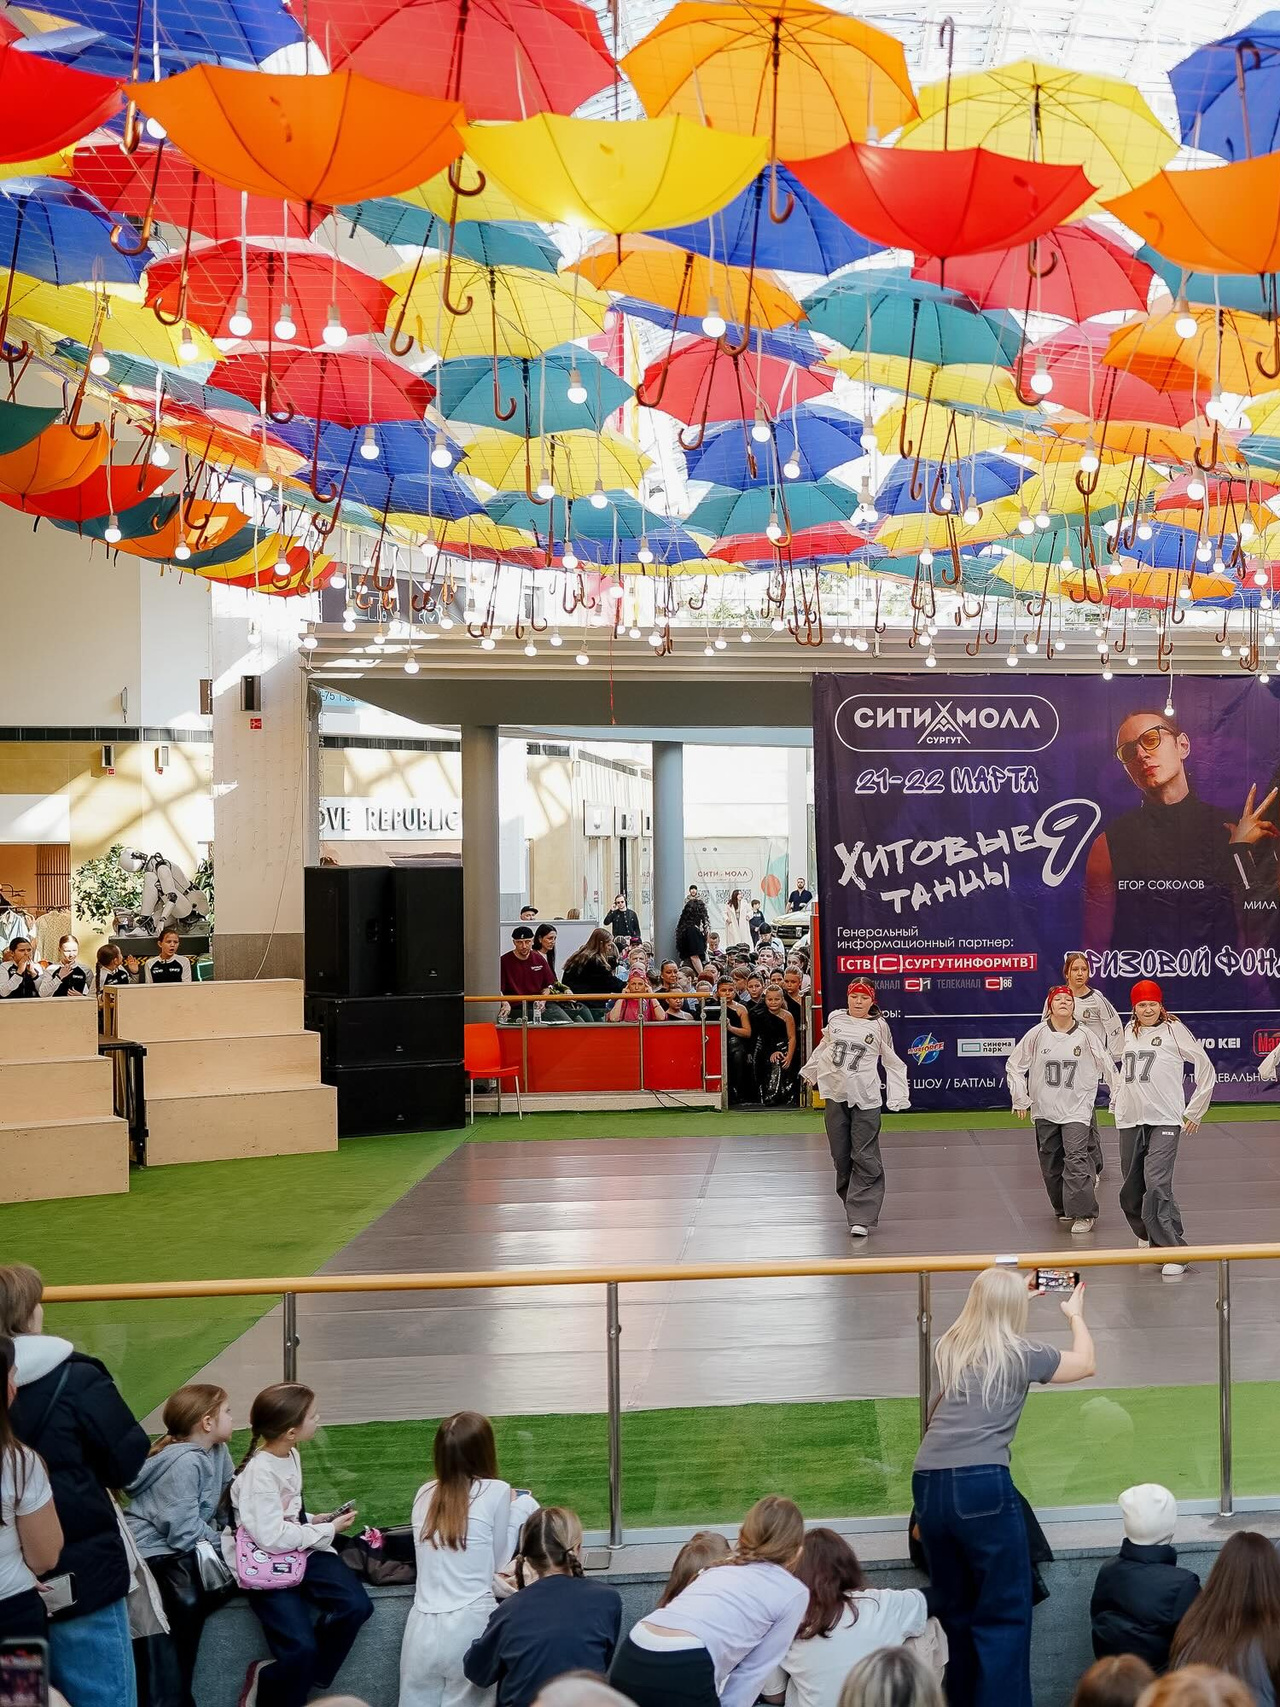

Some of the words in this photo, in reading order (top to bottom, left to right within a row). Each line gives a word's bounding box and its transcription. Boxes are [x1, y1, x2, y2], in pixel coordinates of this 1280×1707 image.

[854, 707, 931, 728] СИТИ
[956, 707, 1041, 728] МОЛЛ
[926, 736, 962, 745] СУРГУТ
[855, 768, 945, 794] 21-22
[951, 766, 1039, 794] МАРТА
[365, 807, 460, 831] REPUBLIC
[880, 861, 1010, 914] ТАНЦЫ
[1118, 880, 1146, 890] ЕГОР
[1148, 879, 1205, 890] СОКОЛОВ
[1243, 900, 1277, 910] МИЛА
[837, 926, 919, 938] Генеральный
[837, 937, 955, 950] информационный
[958, 938, 1014, 949] партнер:
[937, 978, 981, 990] ТЕЛЕКАНАЛ
[1218, 1037, 1241, 1049] KEI
[832, 1038, 867, 1072] 07
[1044, 1060, 1079, 1090] 07
[913, 1078, 943, 1089] ШОУ
[954, 1077, 996, 1088] БАТТЛЫ
